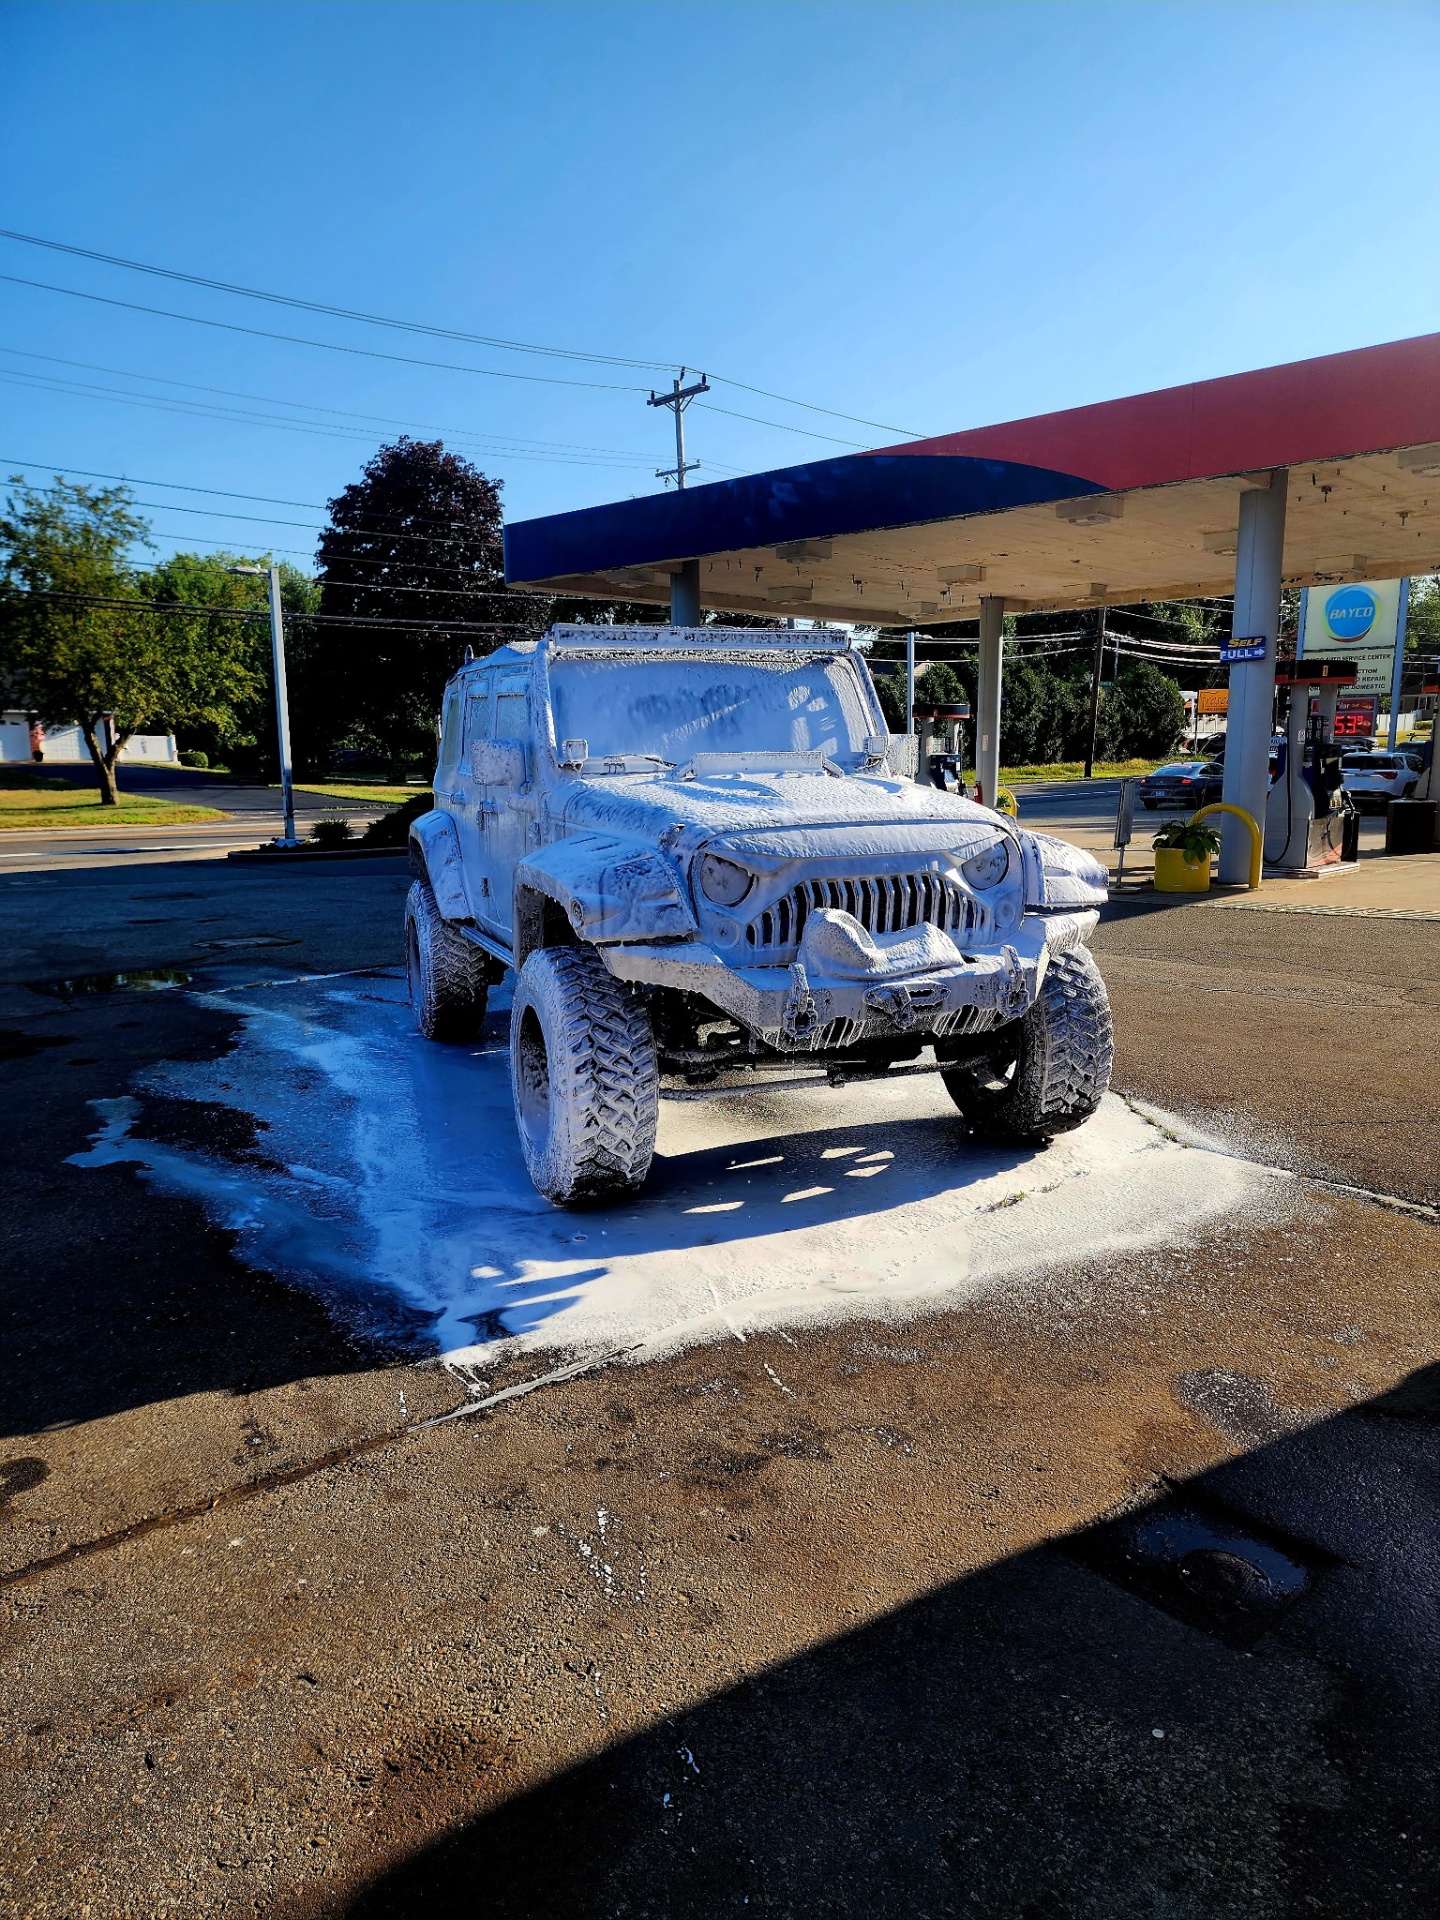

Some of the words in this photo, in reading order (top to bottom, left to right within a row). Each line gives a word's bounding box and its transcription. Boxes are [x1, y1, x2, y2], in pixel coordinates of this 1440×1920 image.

[1330, 607, 1373, 619] BAYCO
[1228, 638, 1262, 648] SELF
[1220, 649, 1252, 659] FULL
